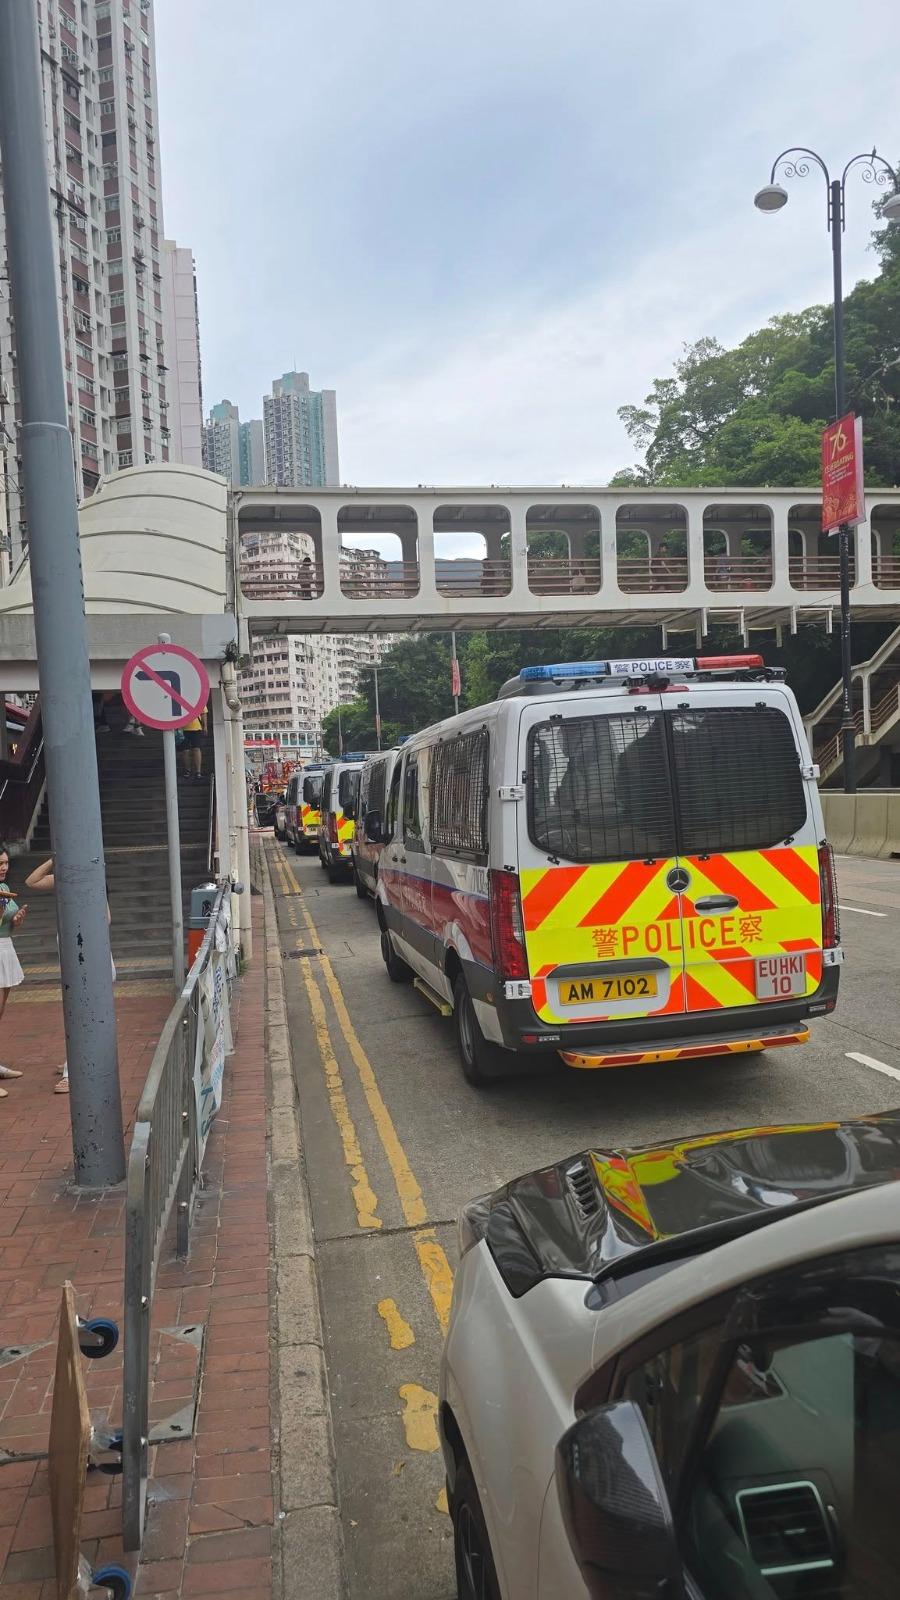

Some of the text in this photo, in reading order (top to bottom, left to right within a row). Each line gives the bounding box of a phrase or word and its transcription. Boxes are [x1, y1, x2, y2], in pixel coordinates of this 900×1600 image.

[631, 661, 673, 672] POLICE
[621, 916, 737, 956] POLICE
[568, 978, 650, 1001] AM 7102
[771, 976, 792, 994] 10
